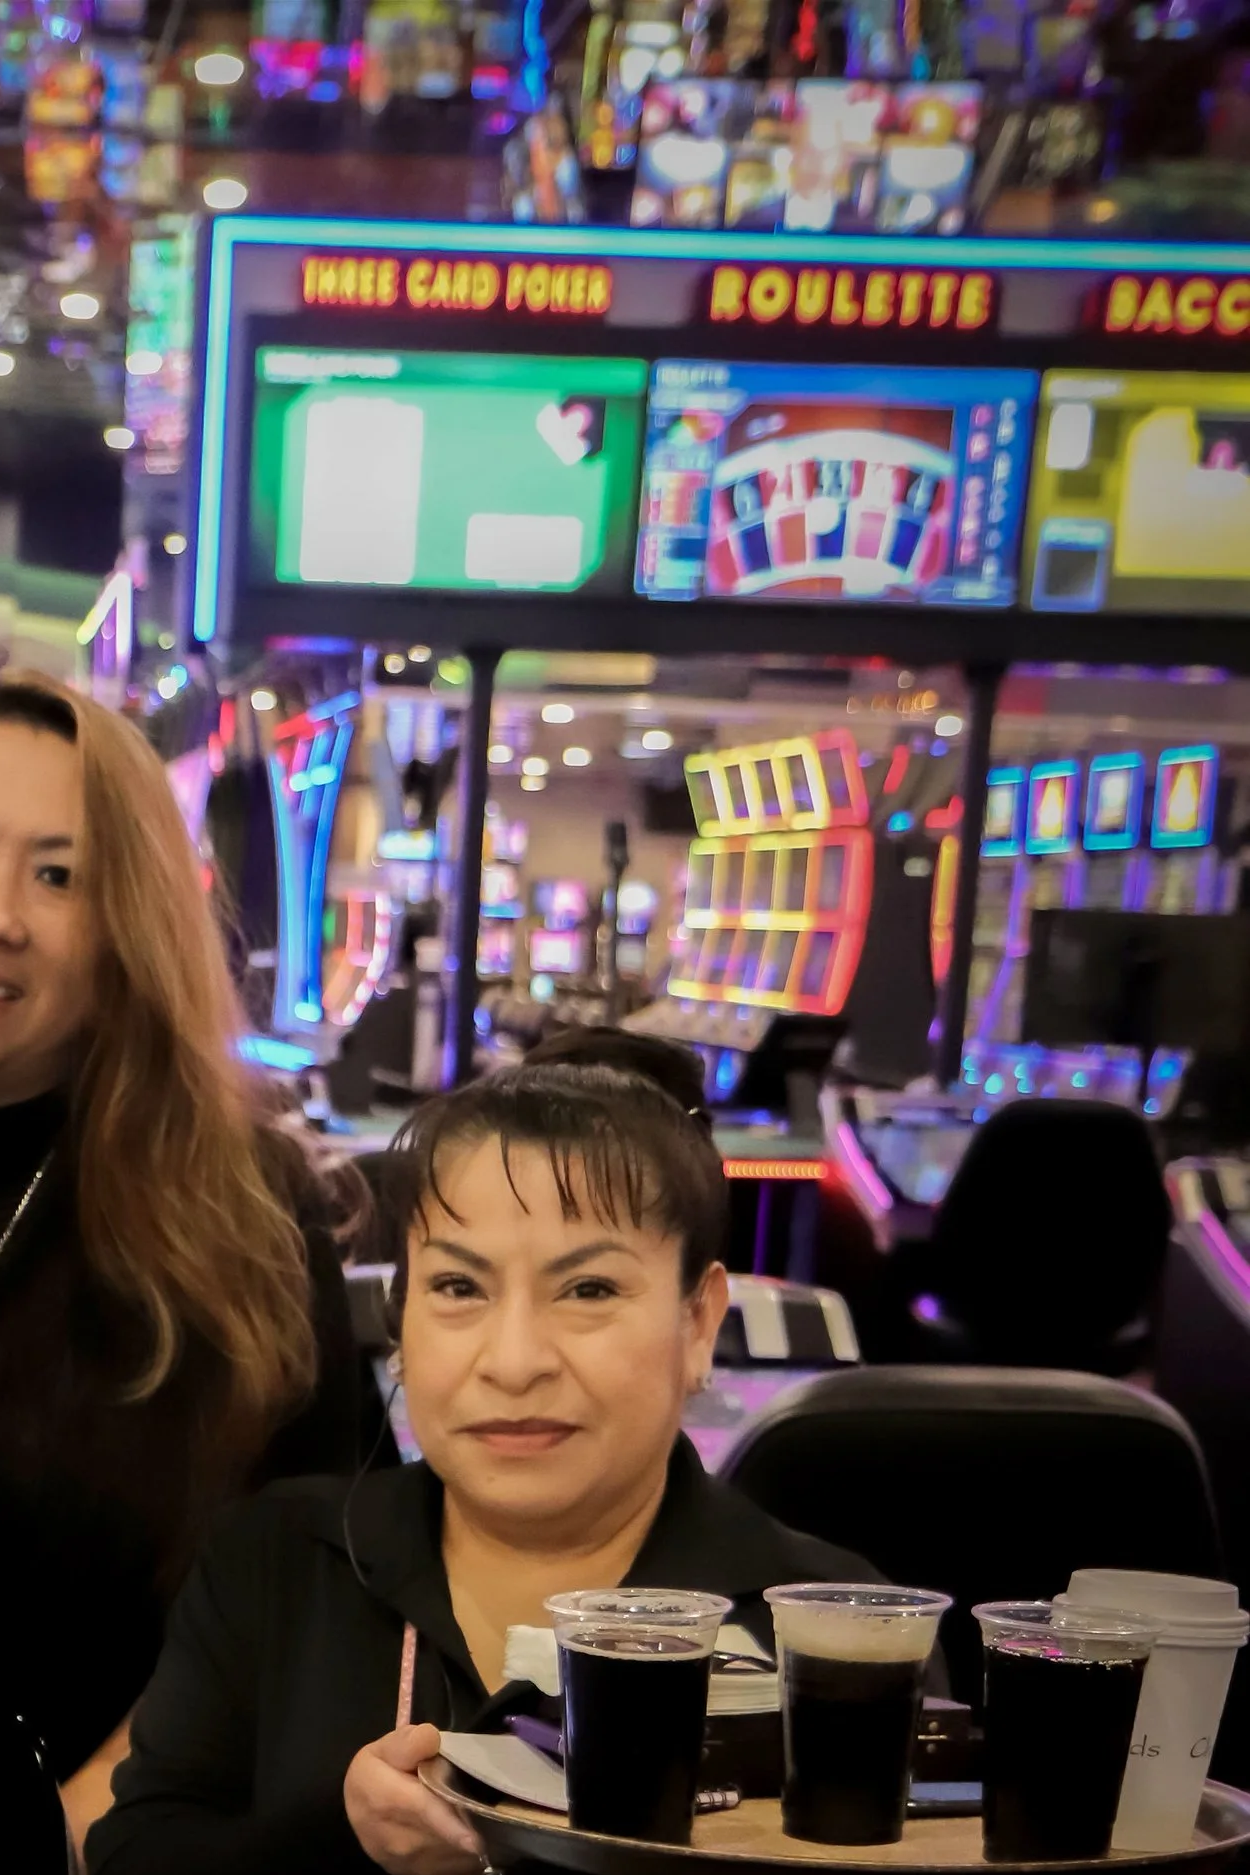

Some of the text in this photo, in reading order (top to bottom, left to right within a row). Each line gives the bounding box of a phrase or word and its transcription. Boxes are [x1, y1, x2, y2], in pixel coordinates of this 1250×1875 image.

[302, 256, 614, 314] THREE CARD POKER
[711, 266, 993, 329] ROULETTE
